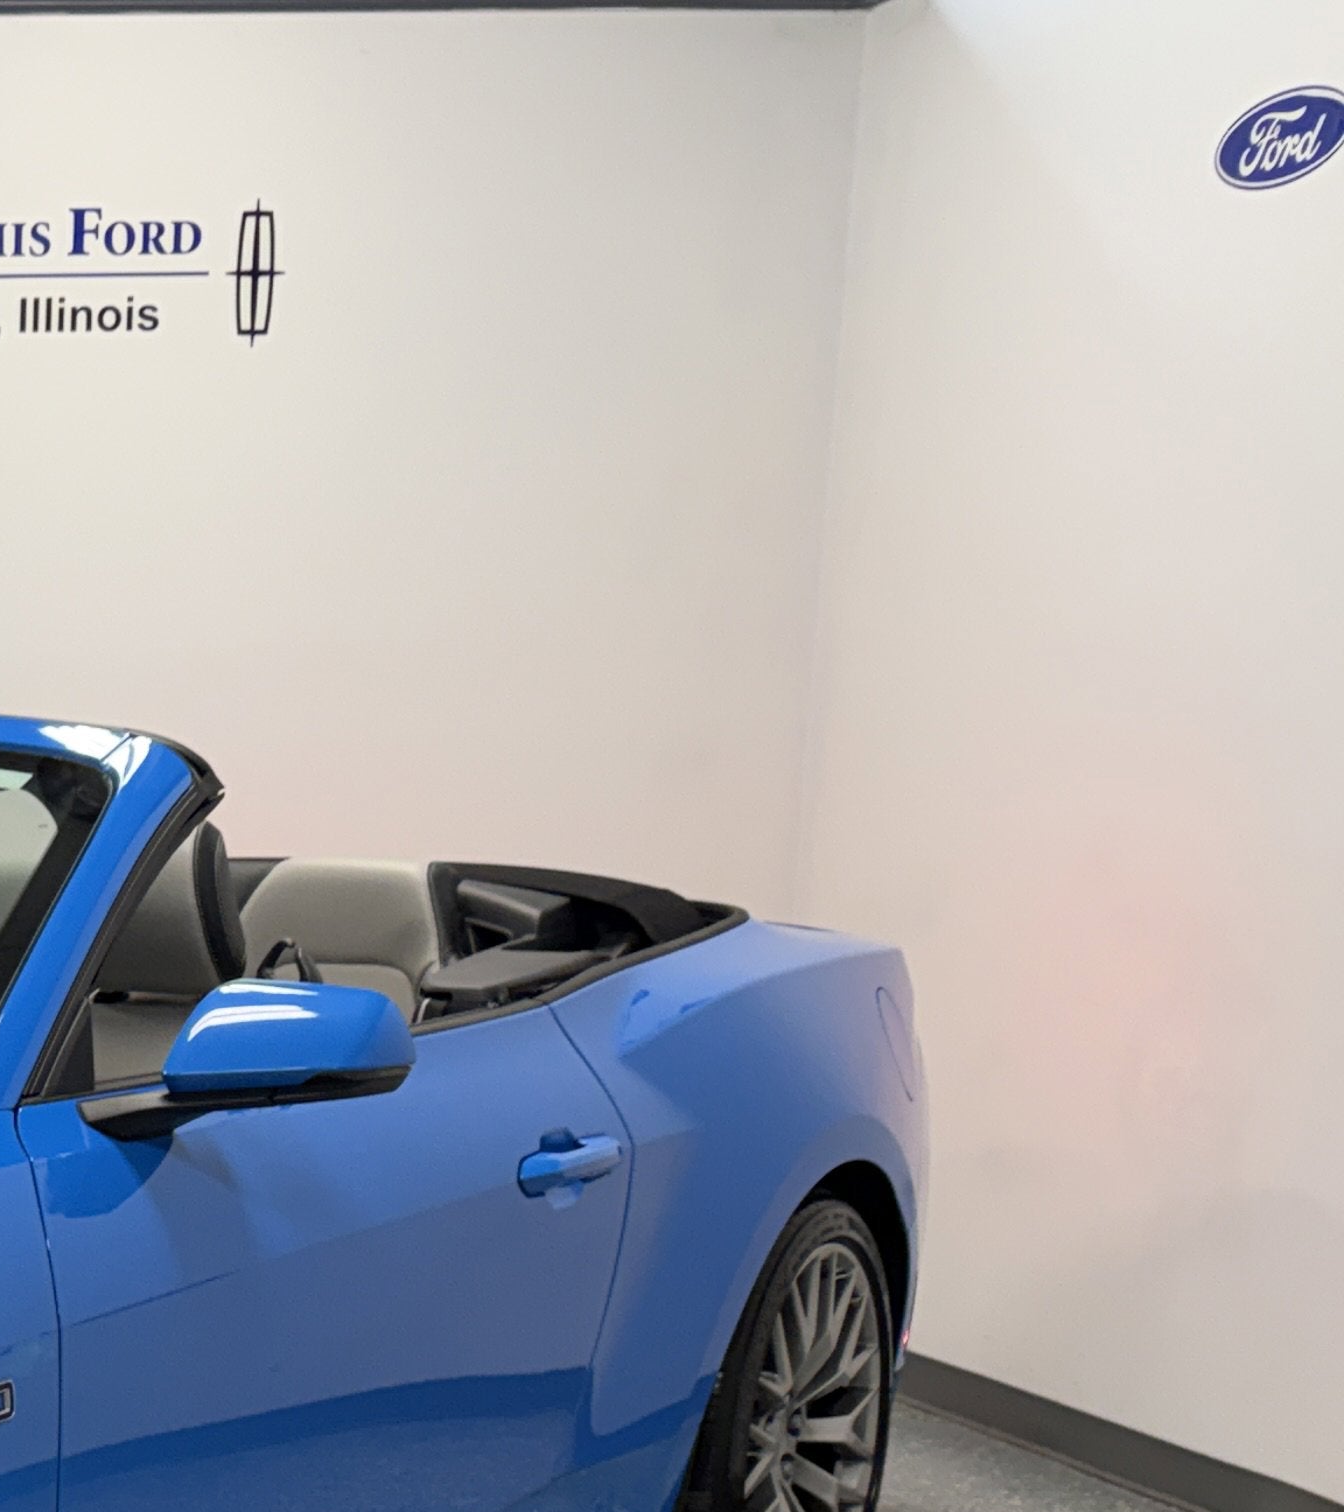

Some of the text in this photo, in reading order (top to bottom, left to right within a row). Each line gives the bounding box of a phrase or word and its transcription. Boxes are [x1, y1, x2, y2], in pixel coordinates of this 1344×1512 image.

[1238, 104, 1327, 178] Ford
[67, 207, 202, 257] FORD
[18, 296, 159, 334] Illinois
